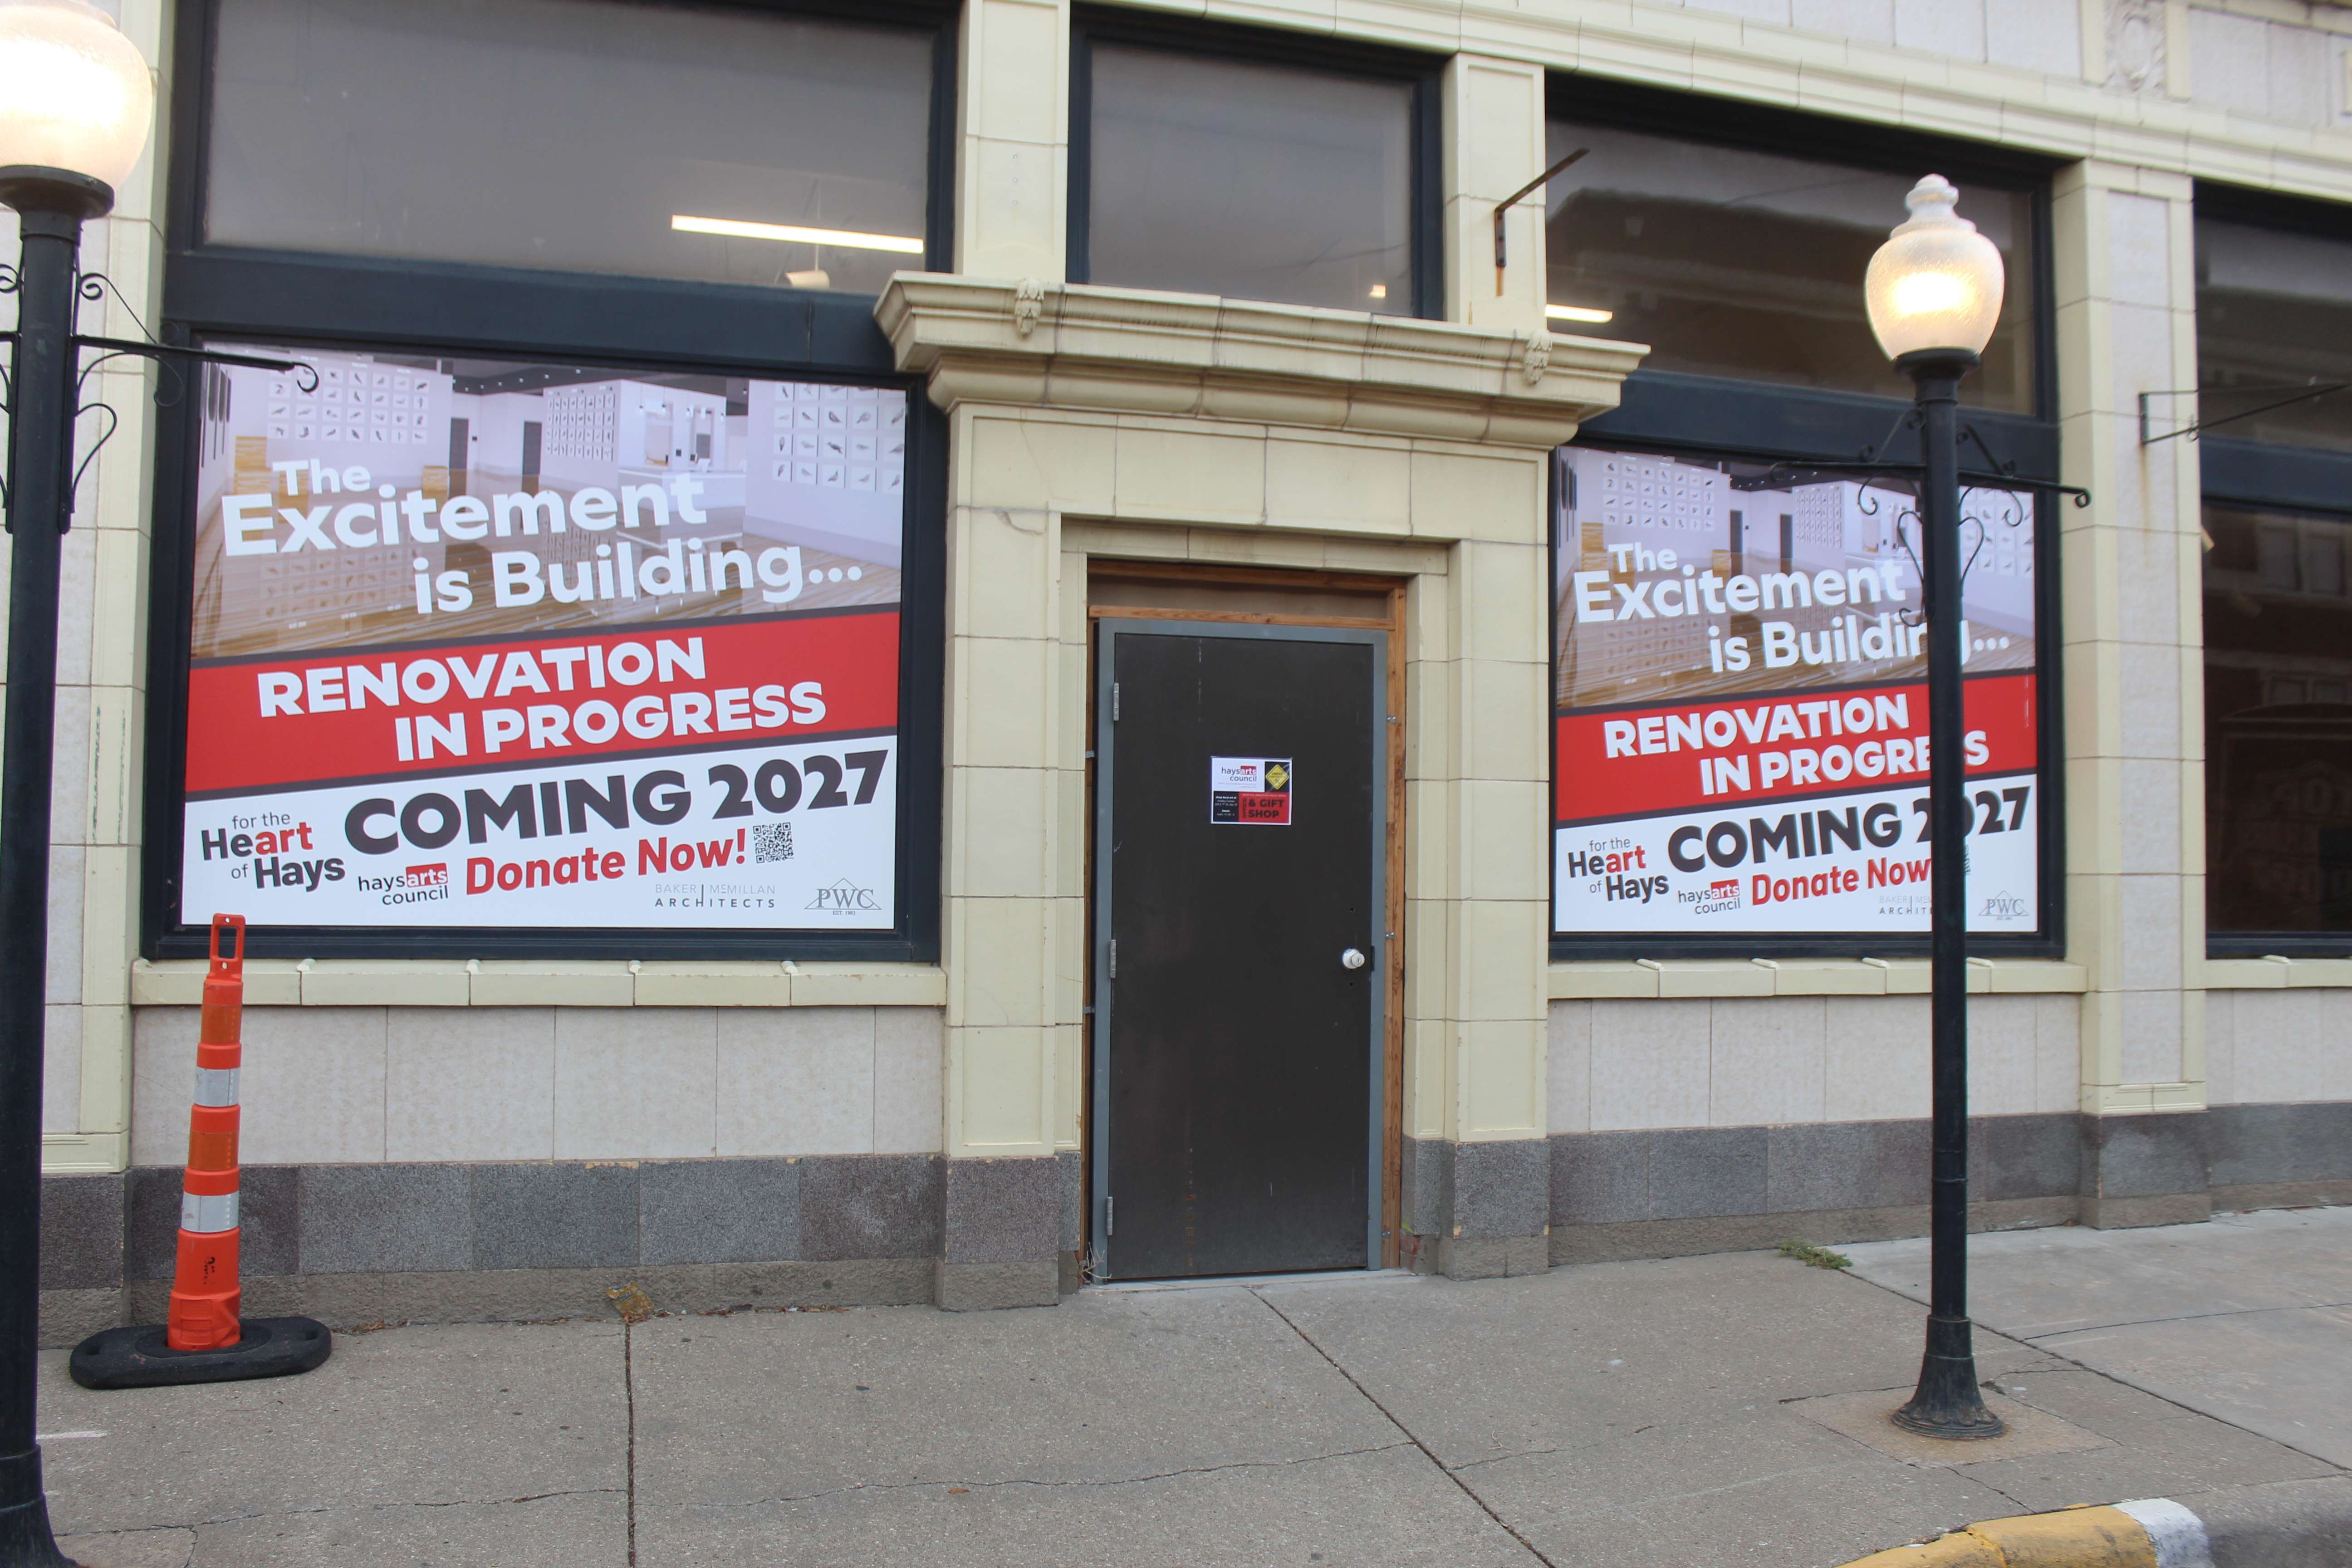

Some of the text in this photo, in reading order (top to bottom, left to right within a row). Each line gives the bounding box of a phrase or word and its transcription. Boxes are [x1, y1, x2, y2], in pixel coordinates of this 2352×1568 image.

[272, 458, 371, 496] The
[221, 472, 707, 556] Excitement
[412, 537, 862, 614] is Building...
[1608, 542, 1677, 573] The
[1573, 558, 1906, 624] Excitement
[1708, 611, 2009, 674] is Buildin...
[257, 636, 706, 717] RENOVATION
[395, 681, 827, 762] IN PROGRESS
[1603, 693, 1909, 760] RENOVATION
[1700, 730, 1990, 796] IN PROGRES
[232, 812, 291, 829] for the
[343, 750, 889, 855] COMING 2027
[1249, 799, 1284, 808] & GIFT
[1249, 810, 1279, 818] SHOP
[201, 821, 313, 861] Heart
[1589, 837, 1631, 852] for the
[1667, 785, 2031, 873] COMING 227
[231, 856, 346, 892] of Hays
[466, 828, 746, 896] Donate Now!
[1568, 845, 1646, 878] Heart
[382, 885, 449, 905] council
[655, 884, 697, 894] BAKER
[816, 888, 875, 909] PWC
[1589, 874, 1670, 904] of Hays
[1752, 857, 1932, 906] Donate Now
[655, 898, 775, 908] ARCHITECTS
[1694, 897, 1741, 915] council
[1986, 899, 2024, 915] PWC
